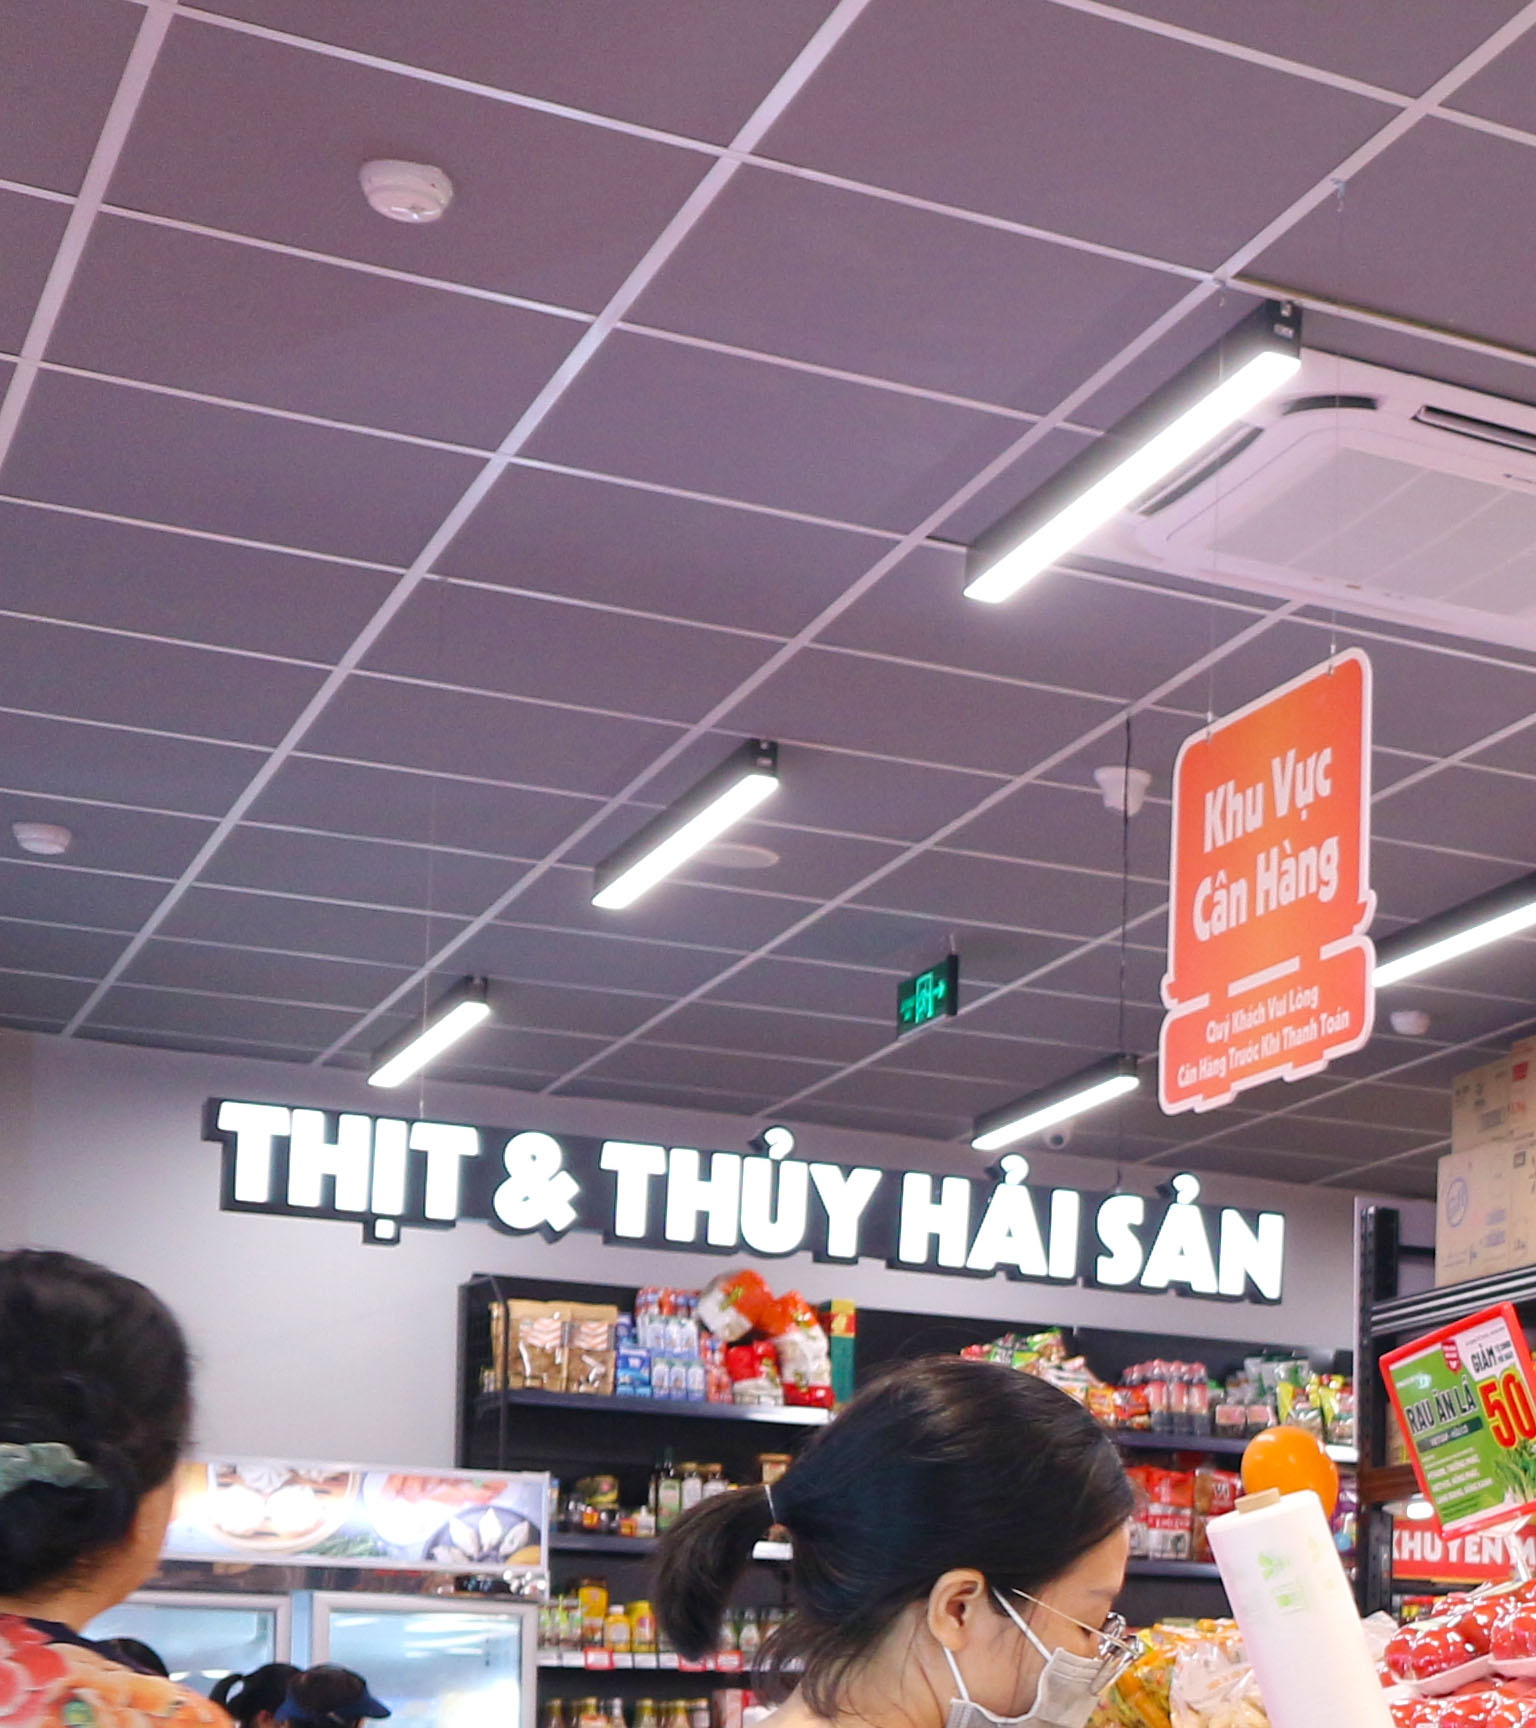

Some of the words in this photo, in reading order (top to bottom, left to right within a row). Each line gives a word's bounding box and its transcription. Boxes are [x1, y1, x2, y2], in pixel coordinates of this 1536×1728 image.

[1203, 780, 1264, 854] Khu
[1271, 747, 1333, 822] Vực
[1192, 868, 1248, 943] Cân
[1255, 835, 1340, 917] Hàng
[1199, 1054, 1228, 1082] Hàng
[1260, 1031, 1280, 1058] Khi
[1282, 1018, 1317, 1053] Thanh
[1319, 1010, 1350, 1037] Toán
[1206, 1018, 1231, 1045] Quý
[1232, 1002, 1266, 1035] Khách
[1266, 993, 1288, 1021] Vui
[1289, 985, 1320, 1019] Lòng
[216, 1100, 481, 1240] THỊT
[492, 1130, 584, 1233] &
[600, 1124, 884, 1260] THỦY
[898, 1154, 1078, 1281] HẢI
[1094, 1172, 1288, 1302] SẢN
[1471, 1341, 1496, 1374] GIẢM
[1406, 1403, 1435, 1435] RAU
[1435, 1389, 1458, 1424] ĂN
[1455, 1375, 1478, 1413] LÁ
